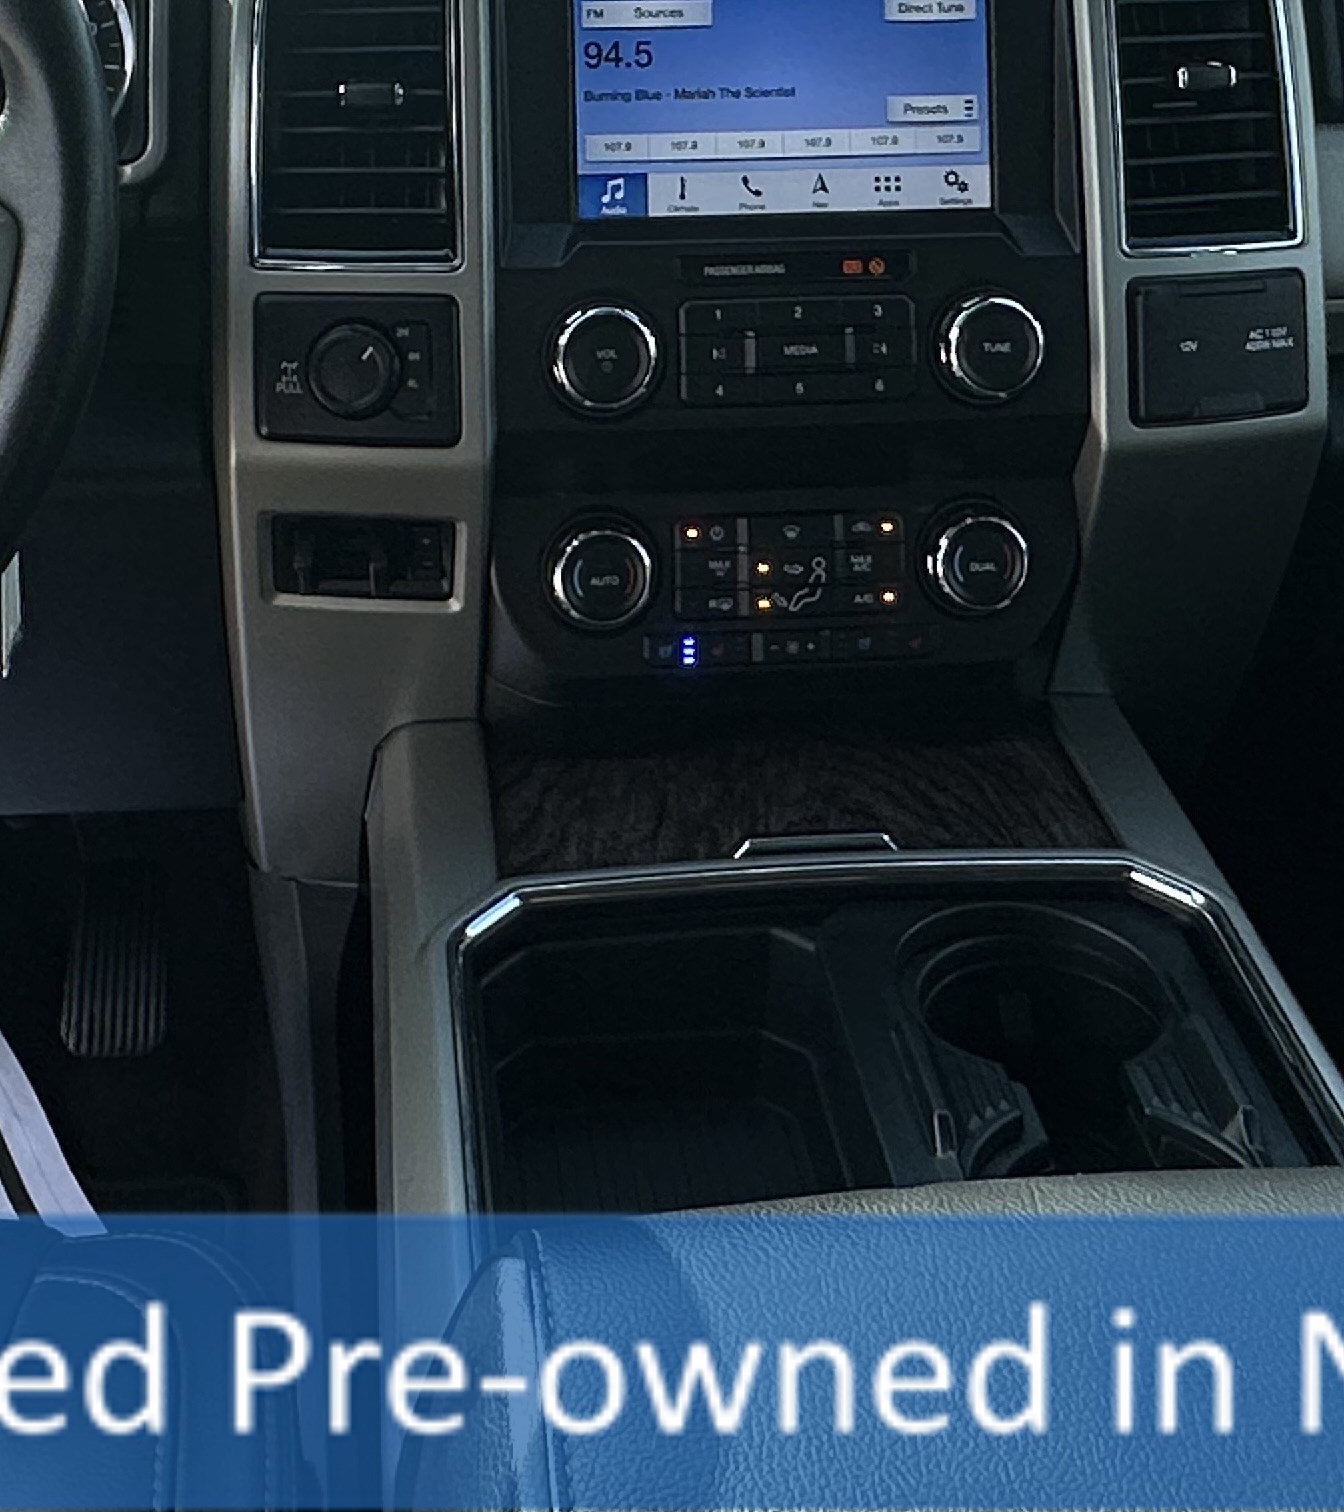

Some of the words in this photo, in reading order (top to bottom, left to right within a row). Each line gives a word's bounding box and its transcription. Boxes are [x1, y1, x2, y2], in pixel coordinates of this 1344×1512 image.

[586, 8, 604, 19] FM
[634, 7, 684, 19] Sources
[898, 2, 933, 14] Direct
[937, 1, 965, 14] Tune
[583, 39, 653, 70] 94.5
[583, 90, 631, 102] Burning
[635, 89, 662, 101] Blue
[675, 88, 715, 99] Mariah
[719, 87, 741, 99] The
[903, 102, 949, 116] Presets
[793, 305, 803, 319] 2
[873, 303, 884, 318] 3
[595, 348, 617, 360] VOL
[782, 344, 818, 356] MEDIA
[982, 342, 1011, 353] TUNE
[715, 384, 725, 397] 4
[969, 561, 997, 573] DUAL
[590, 574, 620, 587] AUTO
